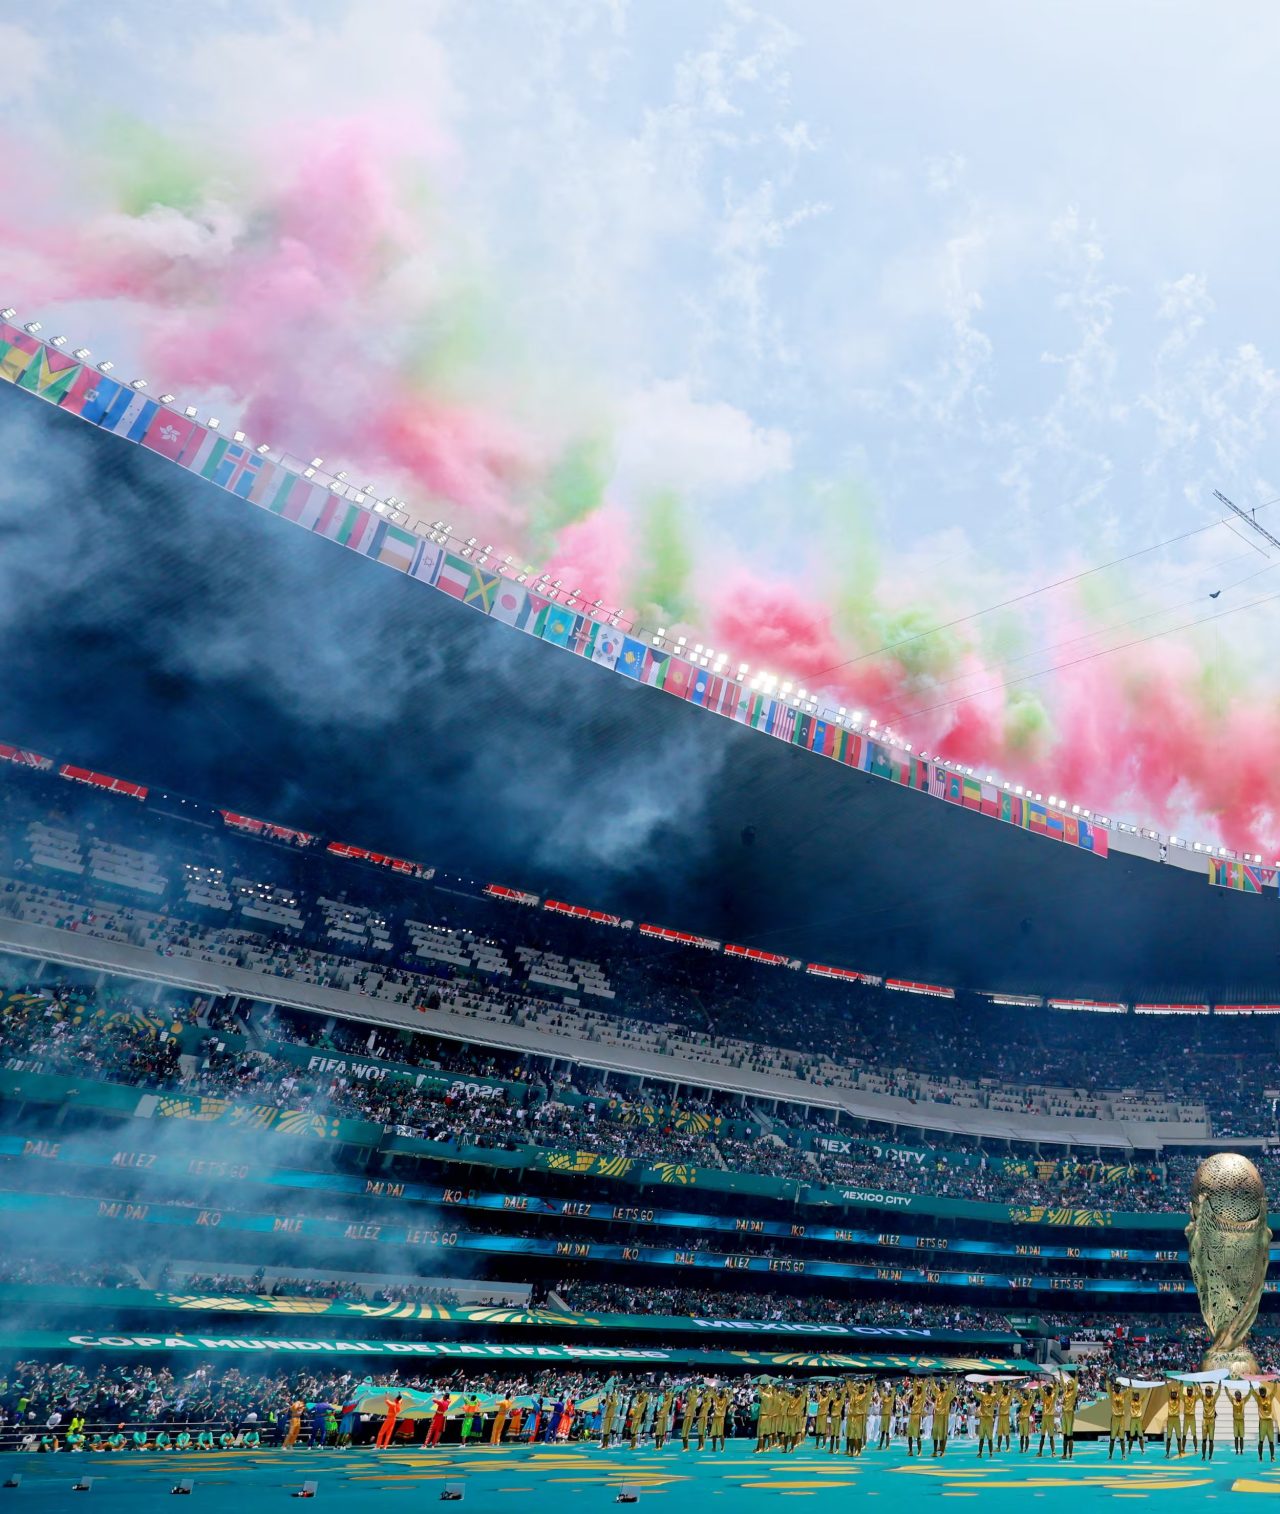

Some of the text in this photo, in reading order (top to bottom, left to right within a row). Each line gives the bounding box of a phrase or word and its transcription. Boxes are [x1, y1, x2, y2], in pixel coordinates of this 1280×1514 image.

[307, 1055, 346, 1074] FIFA
[451, 1080, 504, 1098] 2026
[24, 1141, 61, 1159] DALE
[111, 1151, 157, 1168] ALLEZ
[365, 1180, 384, 1196] DAI
[387, 1183, 405, 1197] DAI
[504, 1196, 528, 1209] DALE
[561, 1202, 591, 1216] ALLEZ
[613, 1207, 638, 1220] LET'S
[641, 1210, 654, 1222] GO
[840, 1190, 912, 1206] MEXICO CITY
[344, 1225, 382, 1240] ALLEZ
[406, 1230, 438, 1244] LET'S
[441, 1231, 457, 1245] GO
[736, 1219, 749, 1231] DAI
[751, 1220, 764, 1232] DAI
[835, 1230, 852, 1241] DALE
[878, 1234, 900, 1245] ALLEZ
[916, 1237, 936, 1248] LET'S
[938, 1238, 948, 1249] GO
[556, 1243, 572, 1255] DAI
[575, 1244, 590, 1256] DAI
[675, 1252, 695, 1265] DALE
[724, 1256, 749, 1269] ALLEZ
[769, 1258, 791, 1271] LET'S
[794, 1261, 805, 1272] GO
[1111, 1250, 1128, 1260] DALE
[1155, 1251, 1178, 1261] ALLEZ
[968, 1275, 985, 1285] DALE
[1009, 1277, 1032, 1288] LLEZ
[1050, 1279, 1071, 1289] LET'S
[1073, 1280, 1084, 1290] GO
[1264, 1283, 1278, 1292] ALE
[692, 1319, 931, 1337] MEXICO CITY
[68, 1335, 671, 1359] COPA MUNDIAL DE LA FIFA 2026
